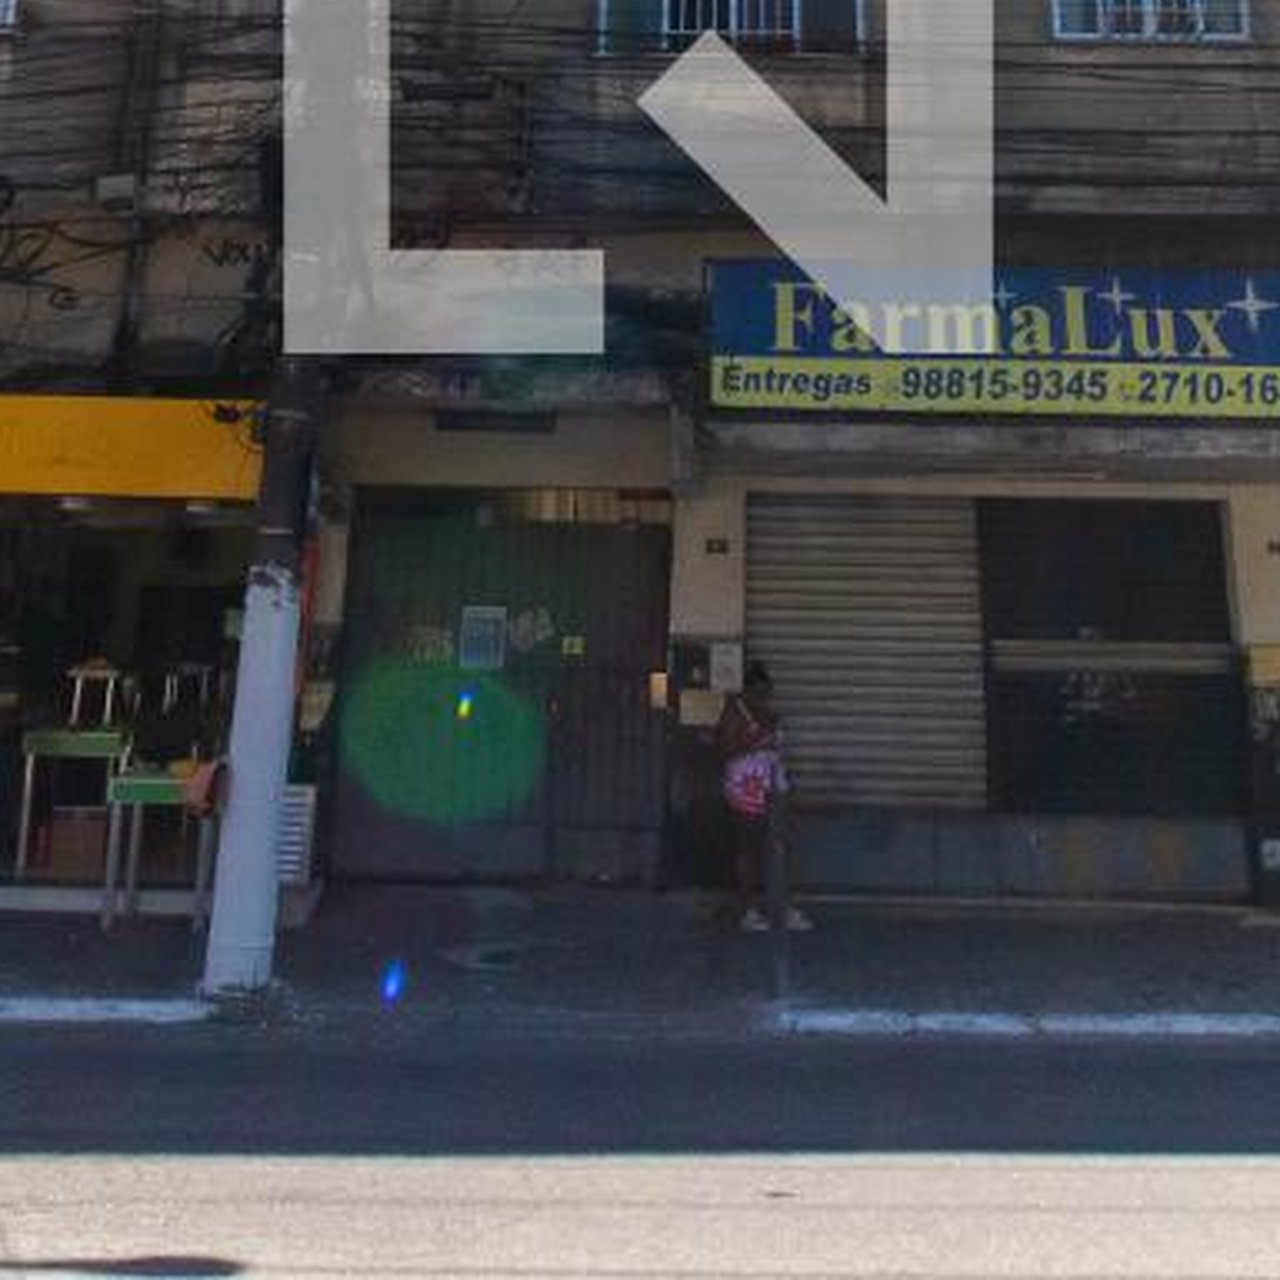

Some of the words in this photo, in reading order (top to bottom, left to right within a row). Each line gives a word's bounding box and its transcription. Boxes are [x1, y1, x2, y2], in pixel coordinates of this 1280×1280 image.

[772, 280, 1234, 360] FarmaLux
[722, 365, 873, 401] Entregas
[901, 368, 1108, 403] 98815-9345
